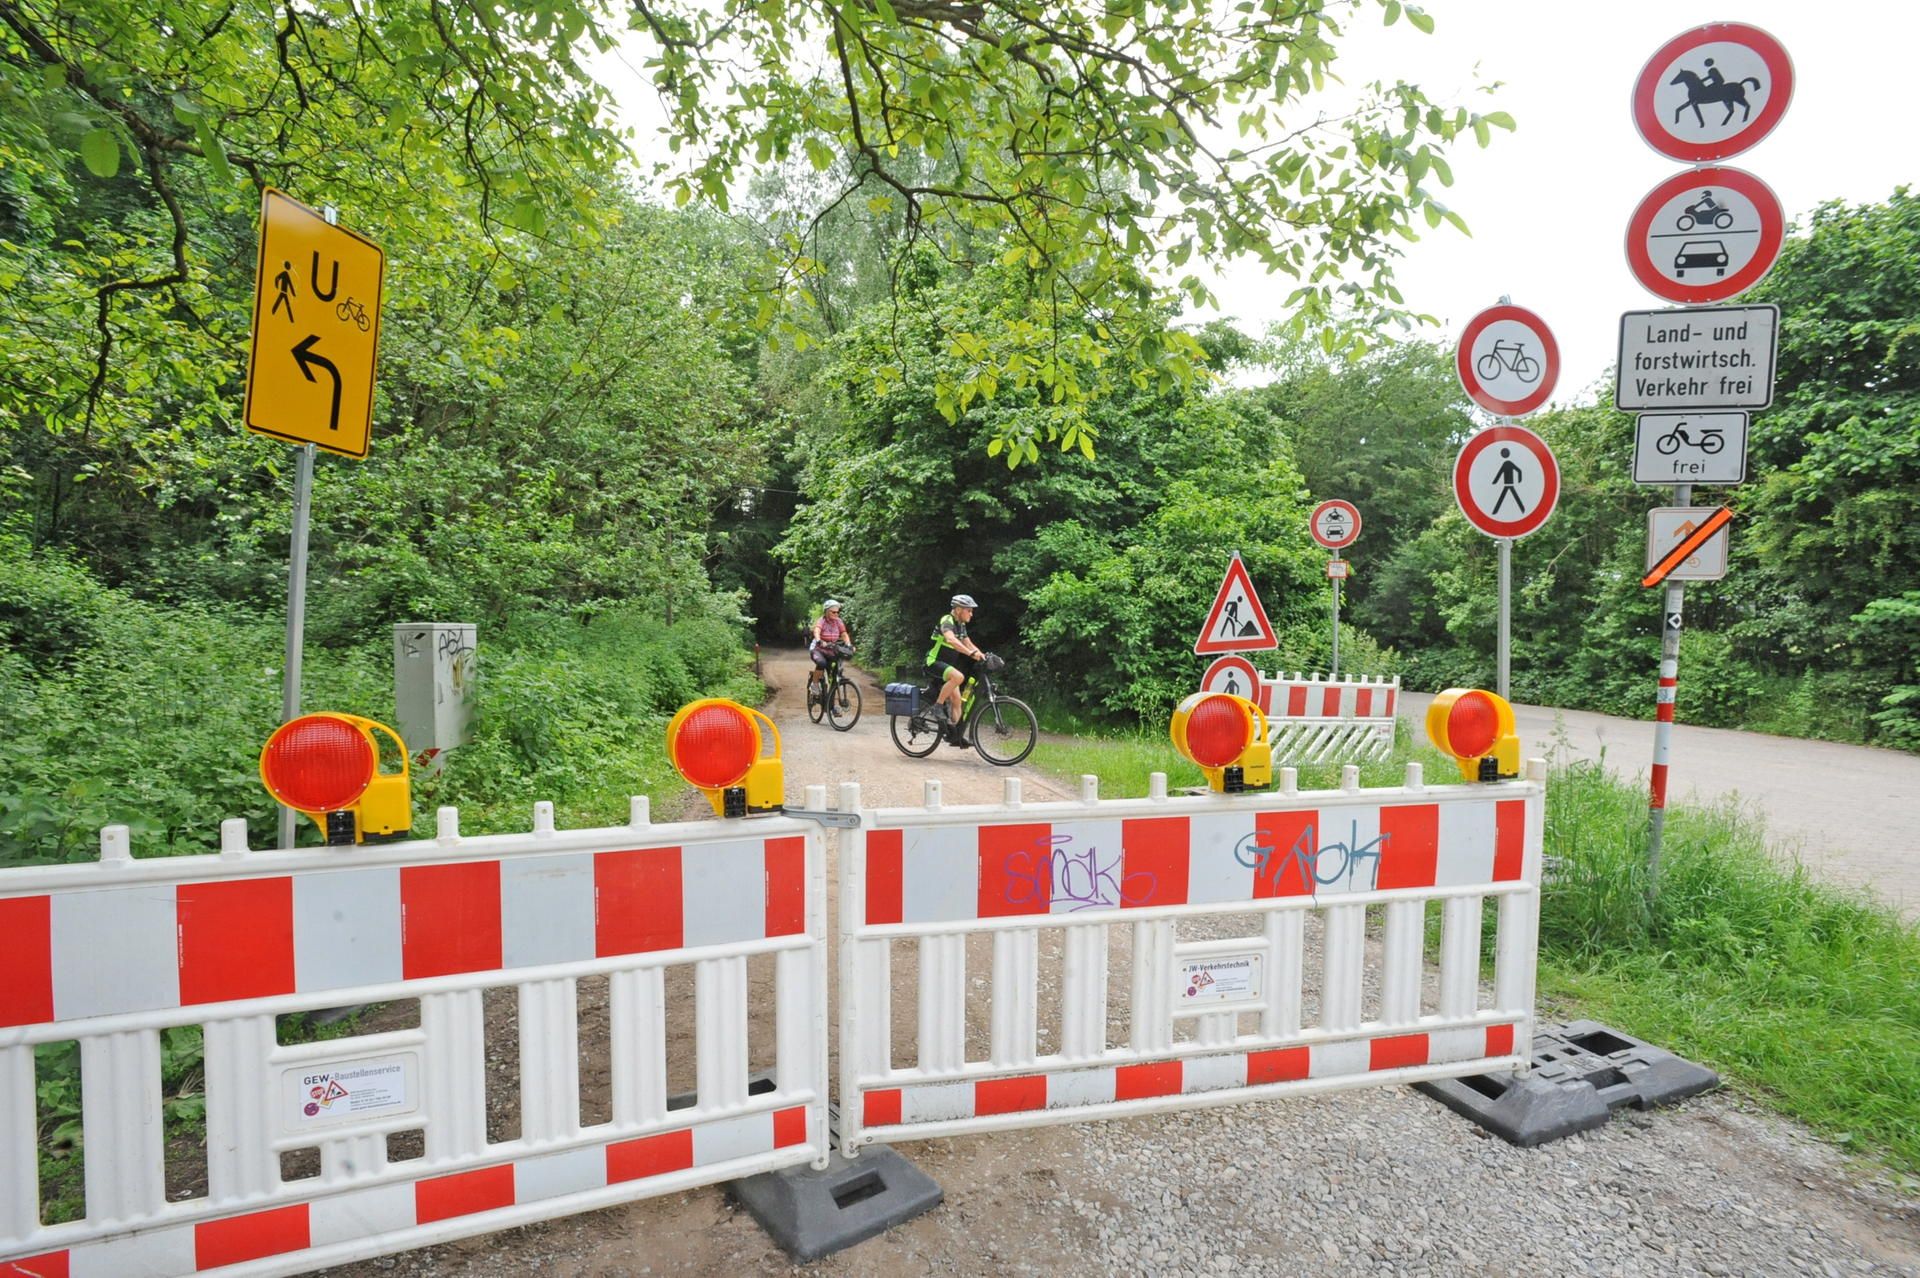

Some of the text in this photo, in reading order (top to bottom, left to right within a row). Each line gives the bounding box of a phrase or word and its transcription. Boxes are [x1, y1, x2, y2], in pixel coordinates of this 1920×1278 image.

[312, 250, 339, 302] U
[1646, 321, 1747, 344] Land- und
[1635, 348, 1756, 371] forstwirtsch.
[1635, 375, 1752, 397] Verkehr frei
[1672, 459, 1705, 474] frei
[1188, 960, 1250, 973] JW-Verkehrstechnik
[303, 1064, 401, 1086] GEW-Baustellenservice
